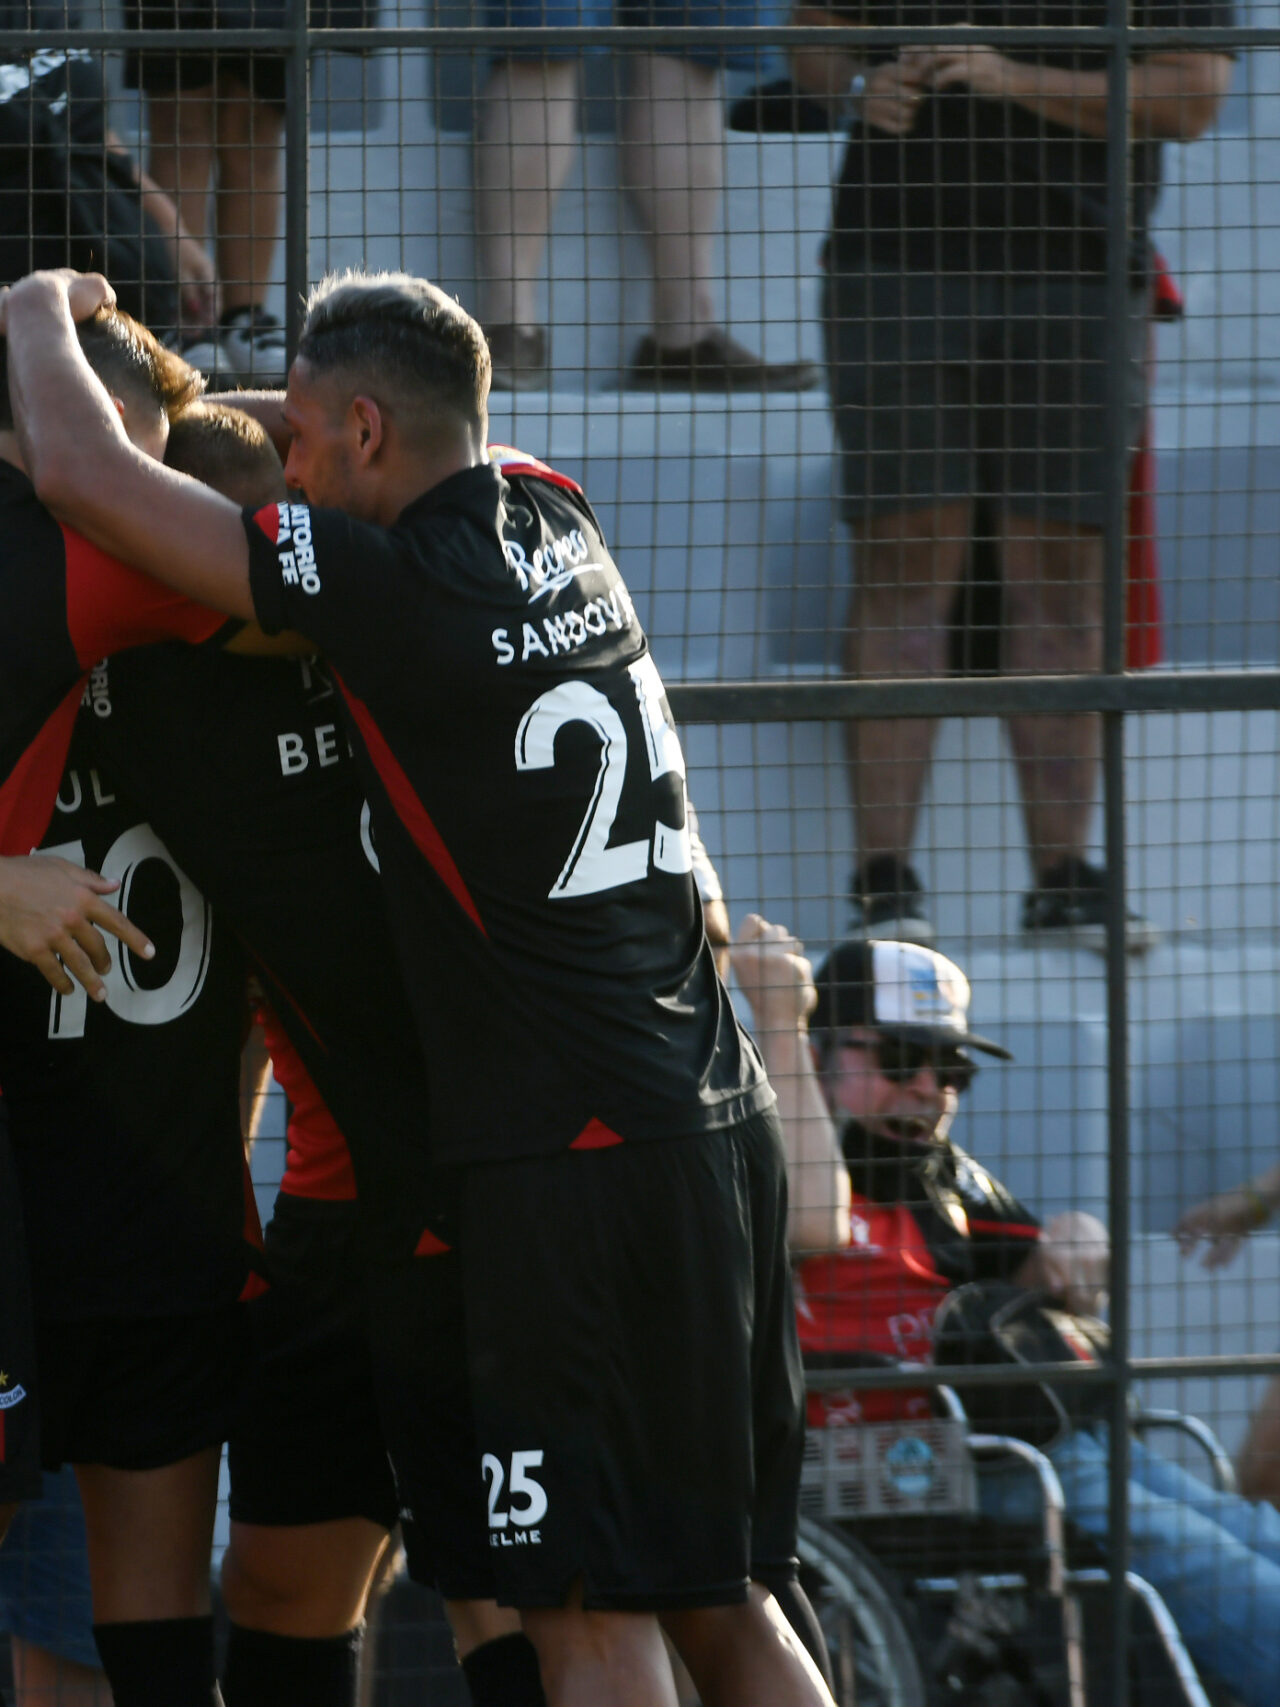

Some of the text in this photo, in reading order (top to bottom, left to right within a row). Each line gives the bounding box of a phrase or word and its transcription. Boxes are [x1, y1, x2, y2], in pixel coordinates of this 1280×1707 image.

[277, 723, 354, 777] BE
[515, 655, 693, 899] 25
[30, 822, 212, 1039] 10
[481, 1450, 548, 1528] 25
